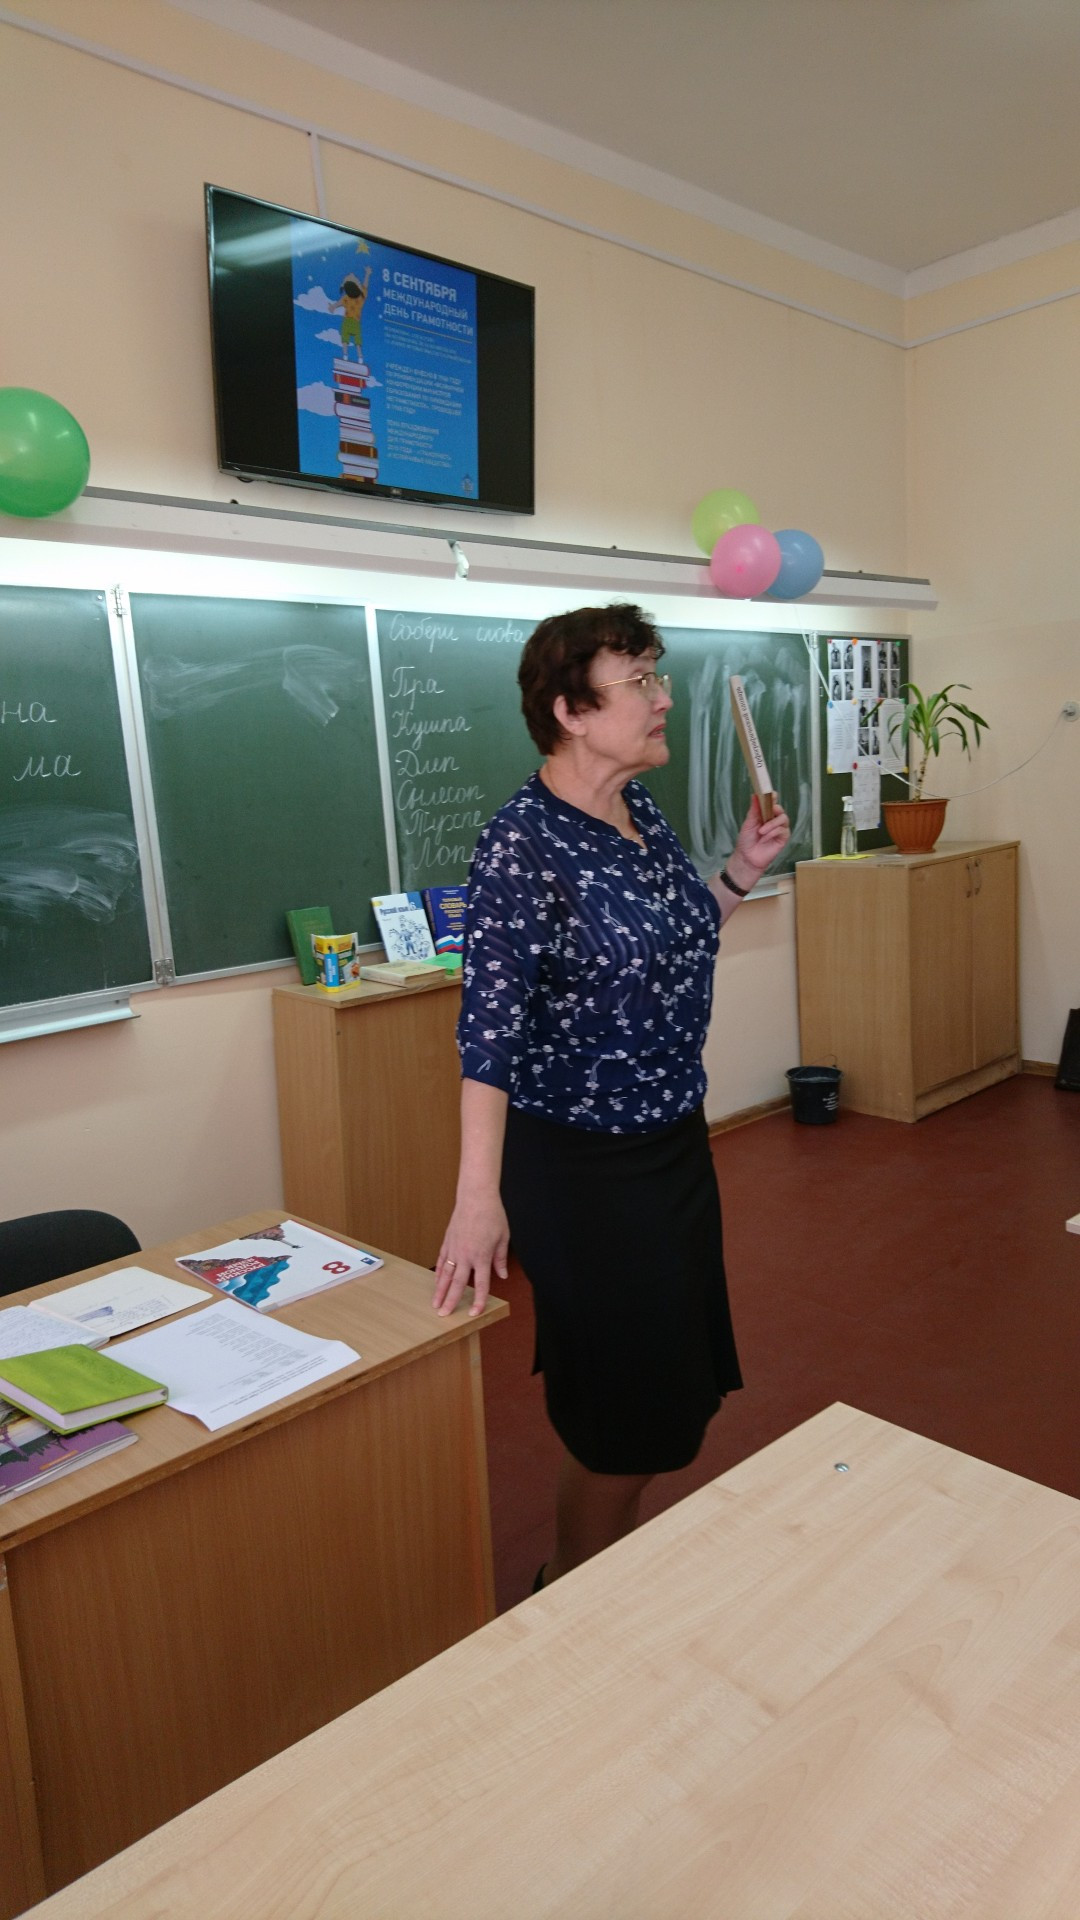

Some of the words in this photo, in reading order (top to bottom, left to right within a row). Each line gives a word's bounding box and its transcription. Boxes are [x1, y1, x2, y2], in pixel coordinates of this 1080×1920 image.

[382, 268, 390, 283] 8
[393, 271, 457, 303] СЕНТЯБРЯ
[383, 287, 469, 320] МЕЖДУНАРОДНЫЙ
[384, 303, 410, 319] ДЕНЬ
[410, 310, 474, 337] ГРАМОТНОСТИ
[389, 613, 459, 653] Собери
[476, 620, 529, 643] слова
[322, 1261, 351, 1275] 8
